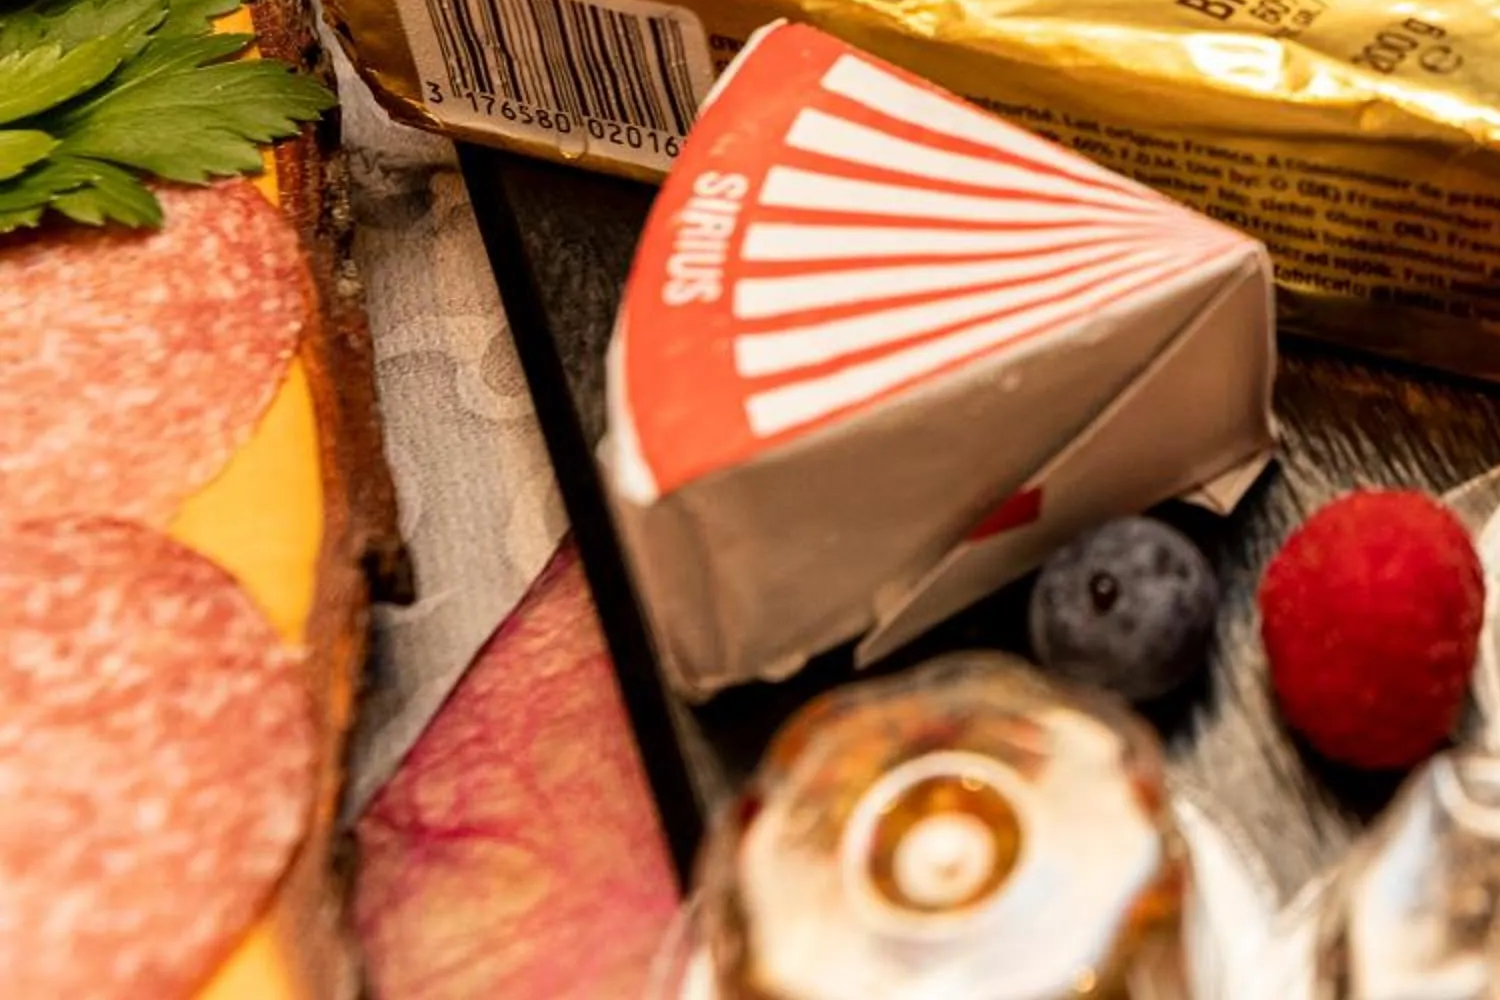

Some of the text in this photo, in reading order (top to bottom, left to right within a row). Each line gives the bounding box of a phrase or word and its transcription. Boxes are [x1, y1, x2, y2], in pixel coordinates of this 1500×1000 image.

[426, 81, 682, 158] 3 176580 02016
[660, 169, 749, 306] SIRIUS
